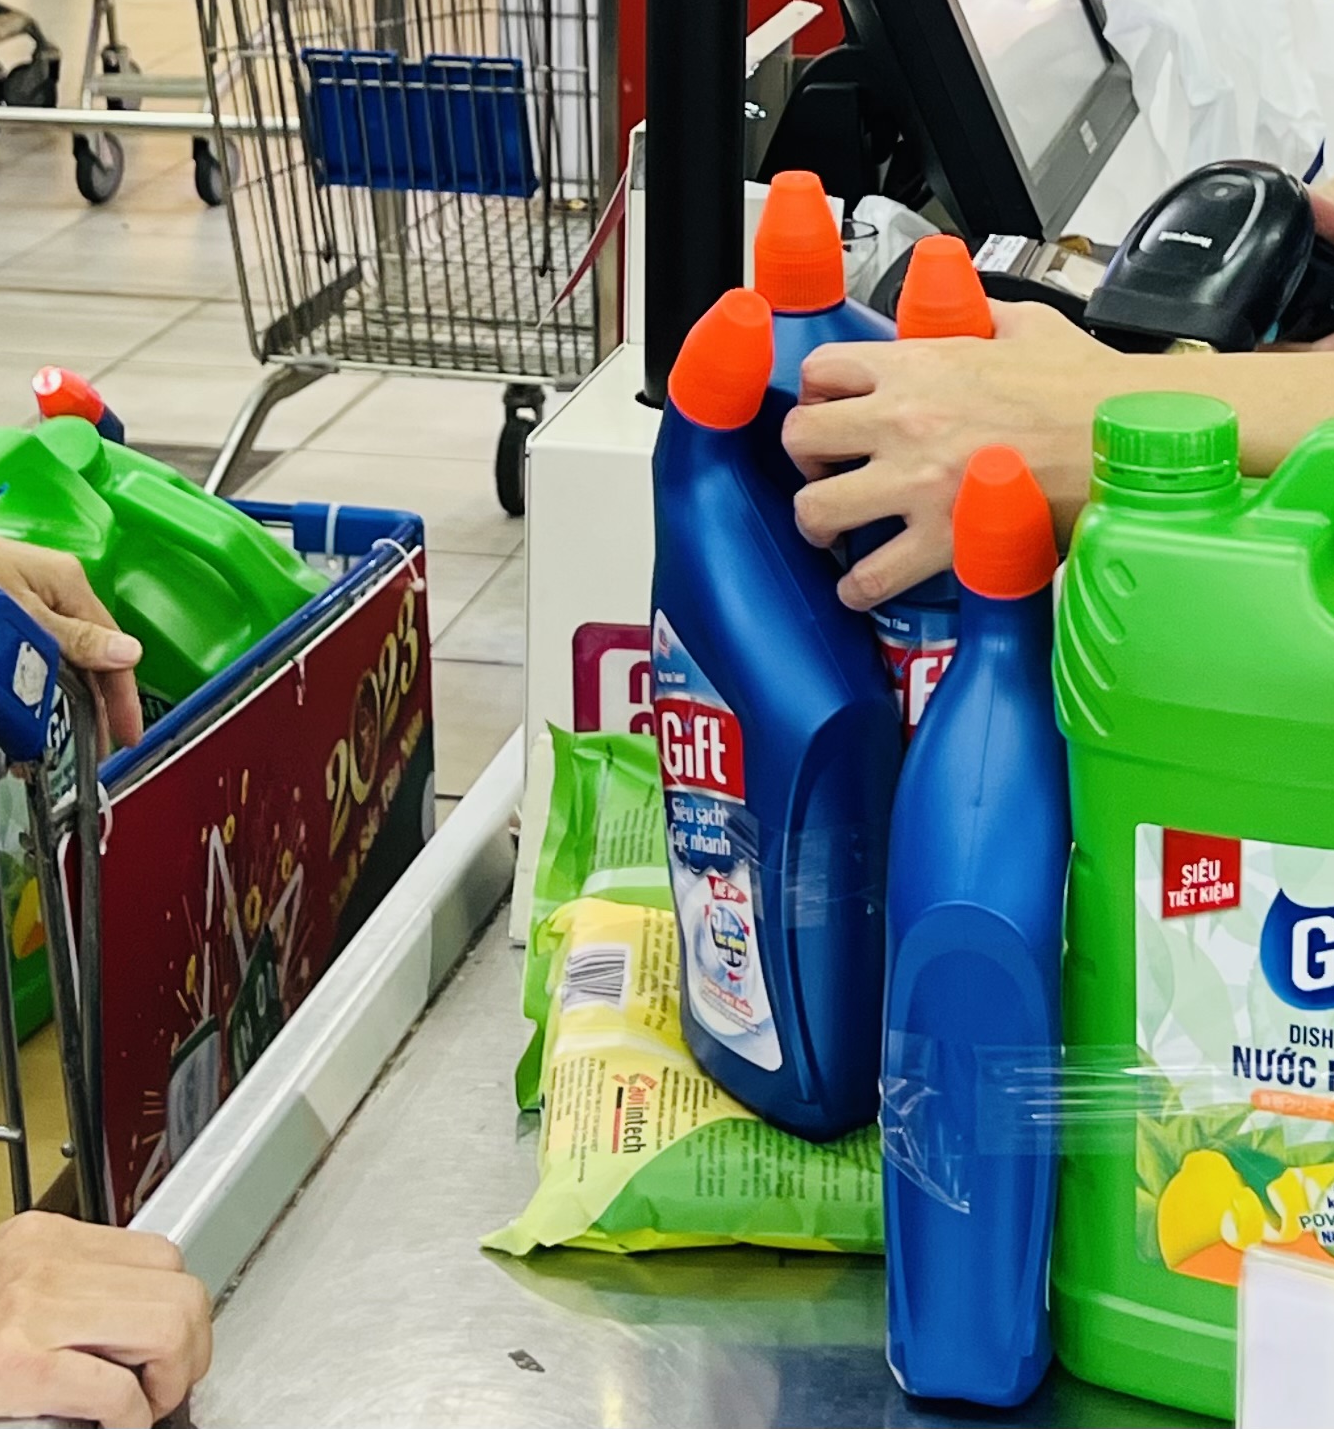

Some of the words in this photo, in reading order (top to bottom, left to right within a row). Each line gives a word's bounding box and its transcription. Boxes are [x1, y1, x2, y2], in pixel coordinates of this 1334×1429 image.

[661, 710, 727, 785] Gift
[671, 797, 694, 823] Siêu
[695, 802, 726, 832] sạch
[689, 828, 732, 857] nhanh
[1181, 857, 1221, 887] SIÊU
[1167, 886, 1198, 909] TIẾT
[1199, 881, 1235, 904] KIỆM
[1289, 1023, 1334, 1049] DISH
[1231, 1044, 1318, 1089] NƯỚC
